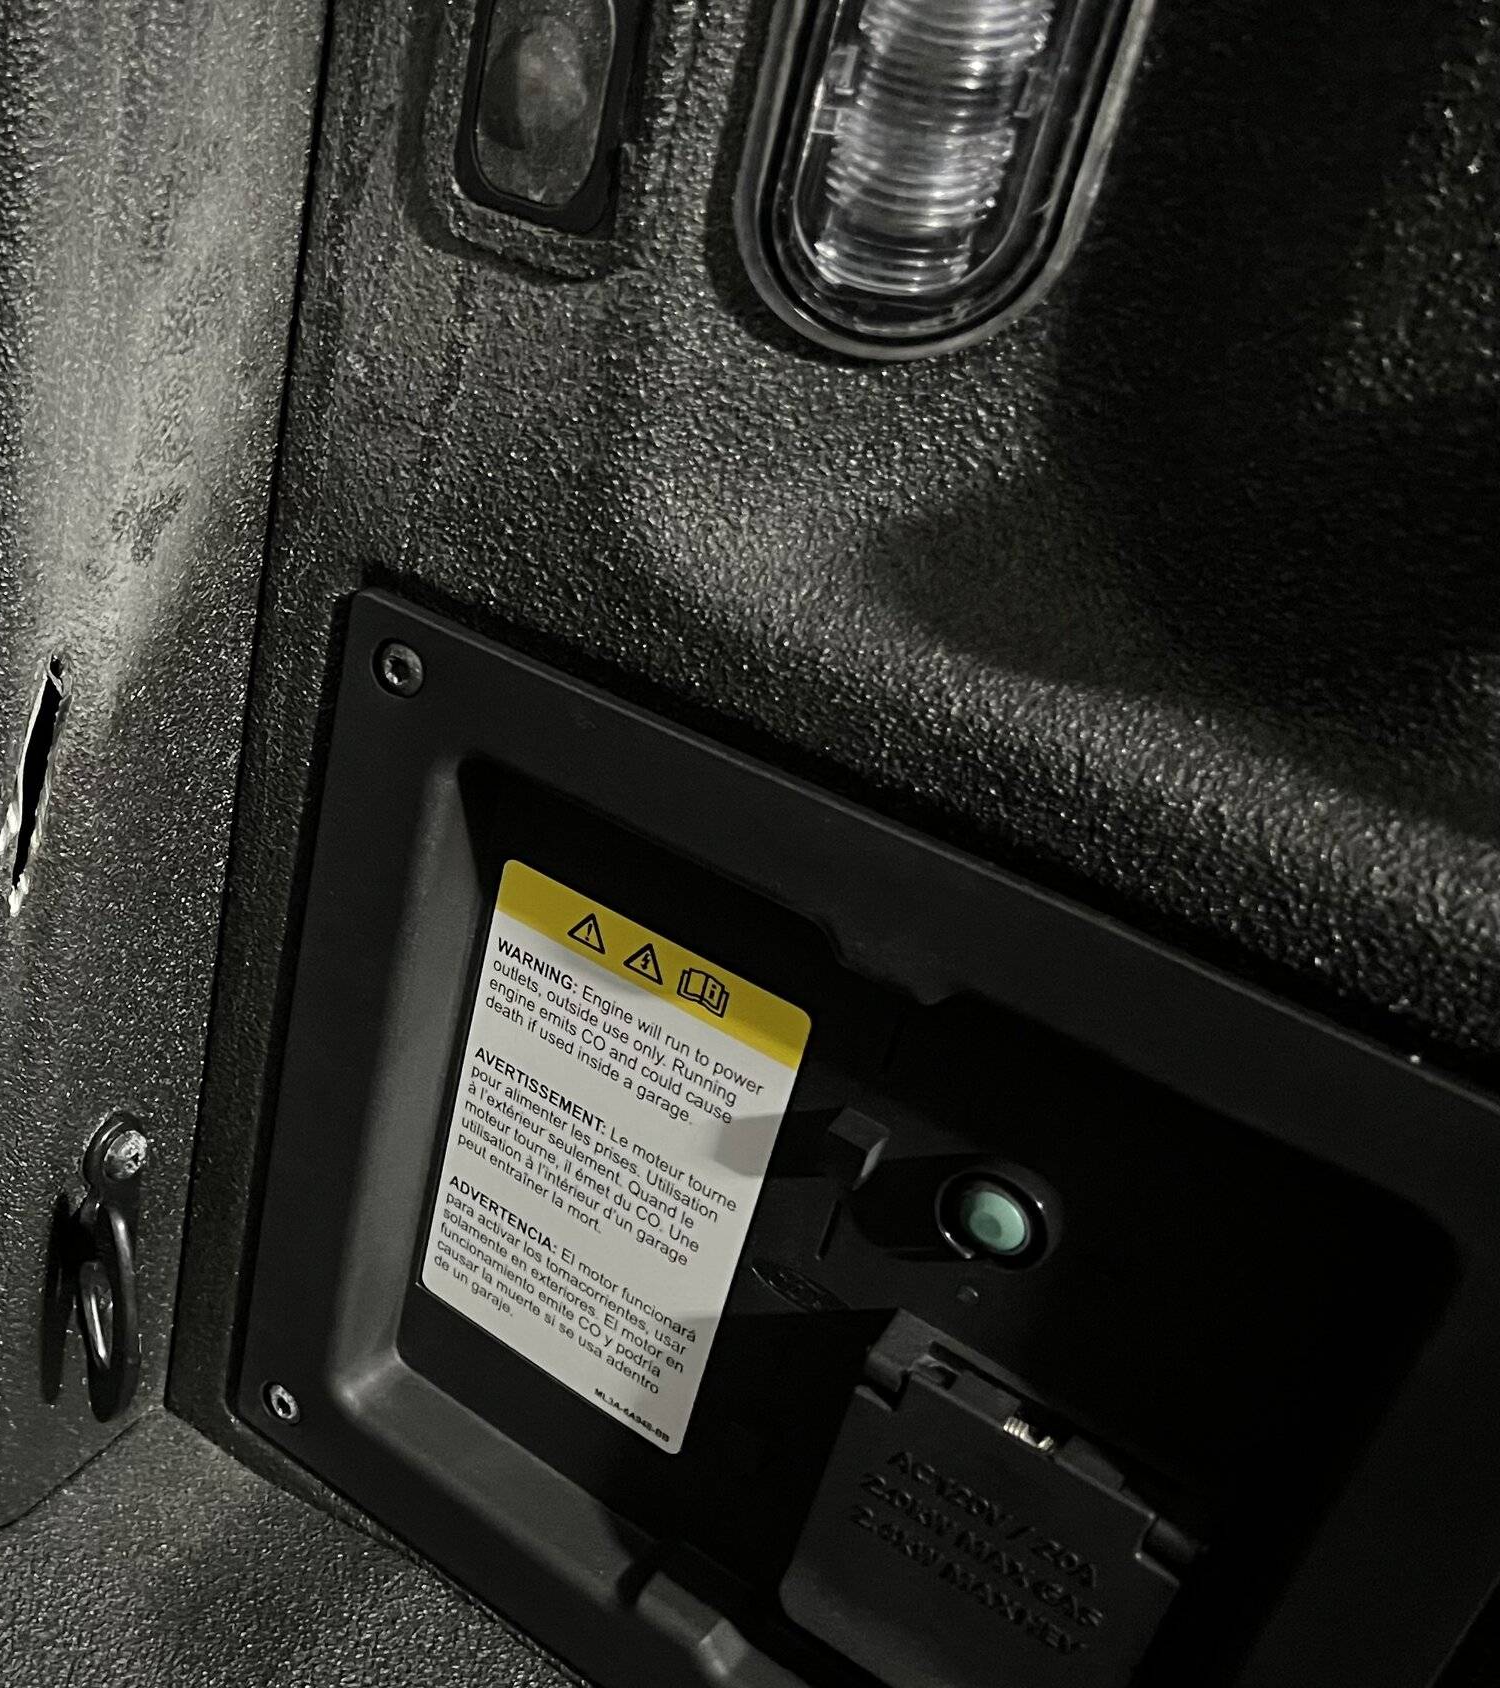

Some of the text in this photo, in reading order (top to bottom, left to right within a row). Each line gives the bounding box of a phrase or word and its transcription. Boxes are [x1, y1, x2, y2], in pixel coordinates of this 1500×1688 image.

[484, 994, 692, 1125] death if used inside a garage.
[488, 977, 732, 1124] engine emits CO and could cause
[492, 959, 737, 1108] outlets, outside use only. Running
[497, 937, 765, 1095] WARNING: Engine will run to power
[456, 1132, 601, 1234] peut entraîner la mort.
[460, 1116, 688, 1266] utilisation à l'intérieur d'un garage
[463, 1099, 699, 1253] moteur tourne, il émet du CO. Une
[466, 1079, 694, 1229] à l'extérieur seulement. Quand le
[469, 1064, 718, 1223] pour alimenter les prises. Utilisation
[473, 1046, 737, 1212] AVERTISSEMENT: Le moteur tourne
[433, 1254, 513, 1317] de un garaje.
[436, 1239, 659, 1394] causar la muerte si se usa adentro
[439, 1221, 661, 1378] funcionamiento emite CO y podría
[442, 1207, 684, 1374] solamente en exteriores. El motor en
[444, 1191, 687, 1355] para activar los tomacorrientes, usar
[448, 1174, 558, 1255] ADVERTENCIA:
[559, 1246, 576, 1266] El
[577, 1261, 619, 1293] motor
[620, 1286, 696, 1344] funcionará
[939, 1562, 1018, 1620] MAX
[952, 1531, 1034, 1588] MAX
[1031, 1581, 1104, 1627] GAS
[1030, 1540, 1096, 1588] 20A
